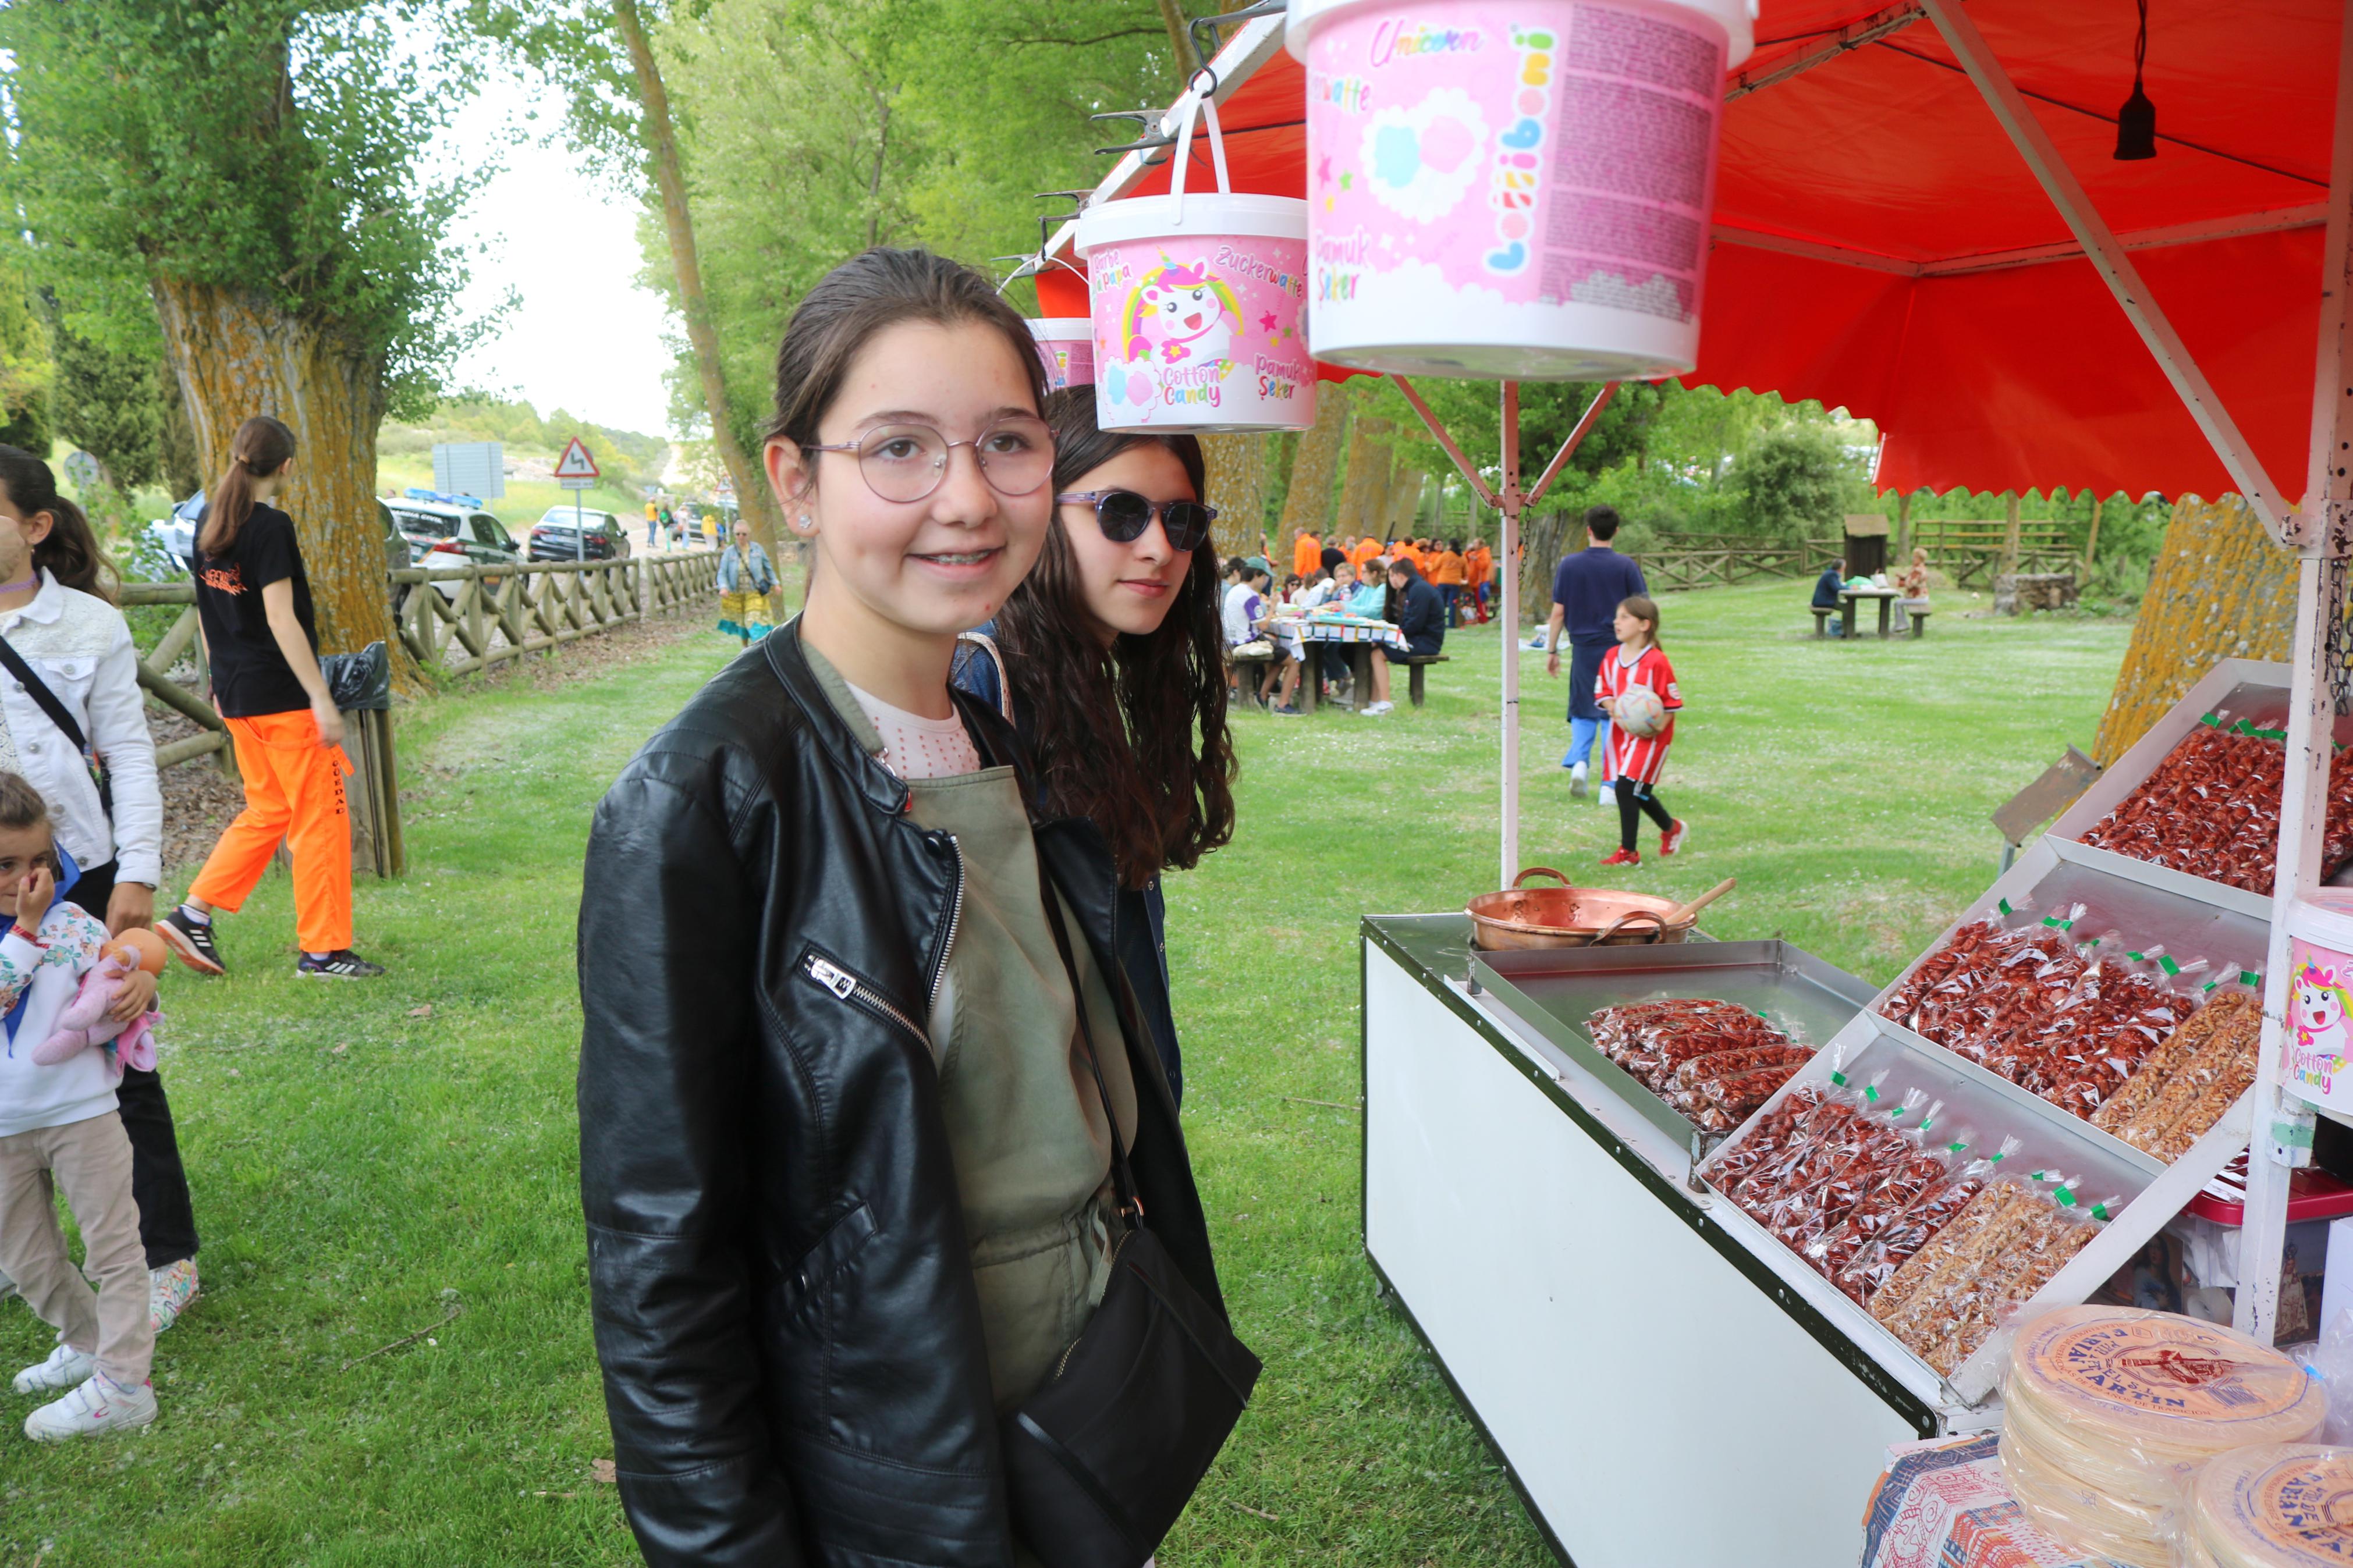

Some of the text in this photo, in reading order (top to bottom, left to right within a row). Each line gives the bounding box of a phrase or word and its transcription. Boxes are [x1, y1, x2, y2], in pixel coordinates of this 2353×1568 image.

[1371, 19, 1484, 67] Unicorn
[1215, 246, 1303, 298] Zuckerwatte
[1164, 367, 1221, 386] Cotton
[1258, 376, 1296, 401] Şeker
[1165, 382, 1221, 408] Candy
[2295, 1047, 2333, 1076] Cotton
[2293, 1064, 2331, 1095] Candy
